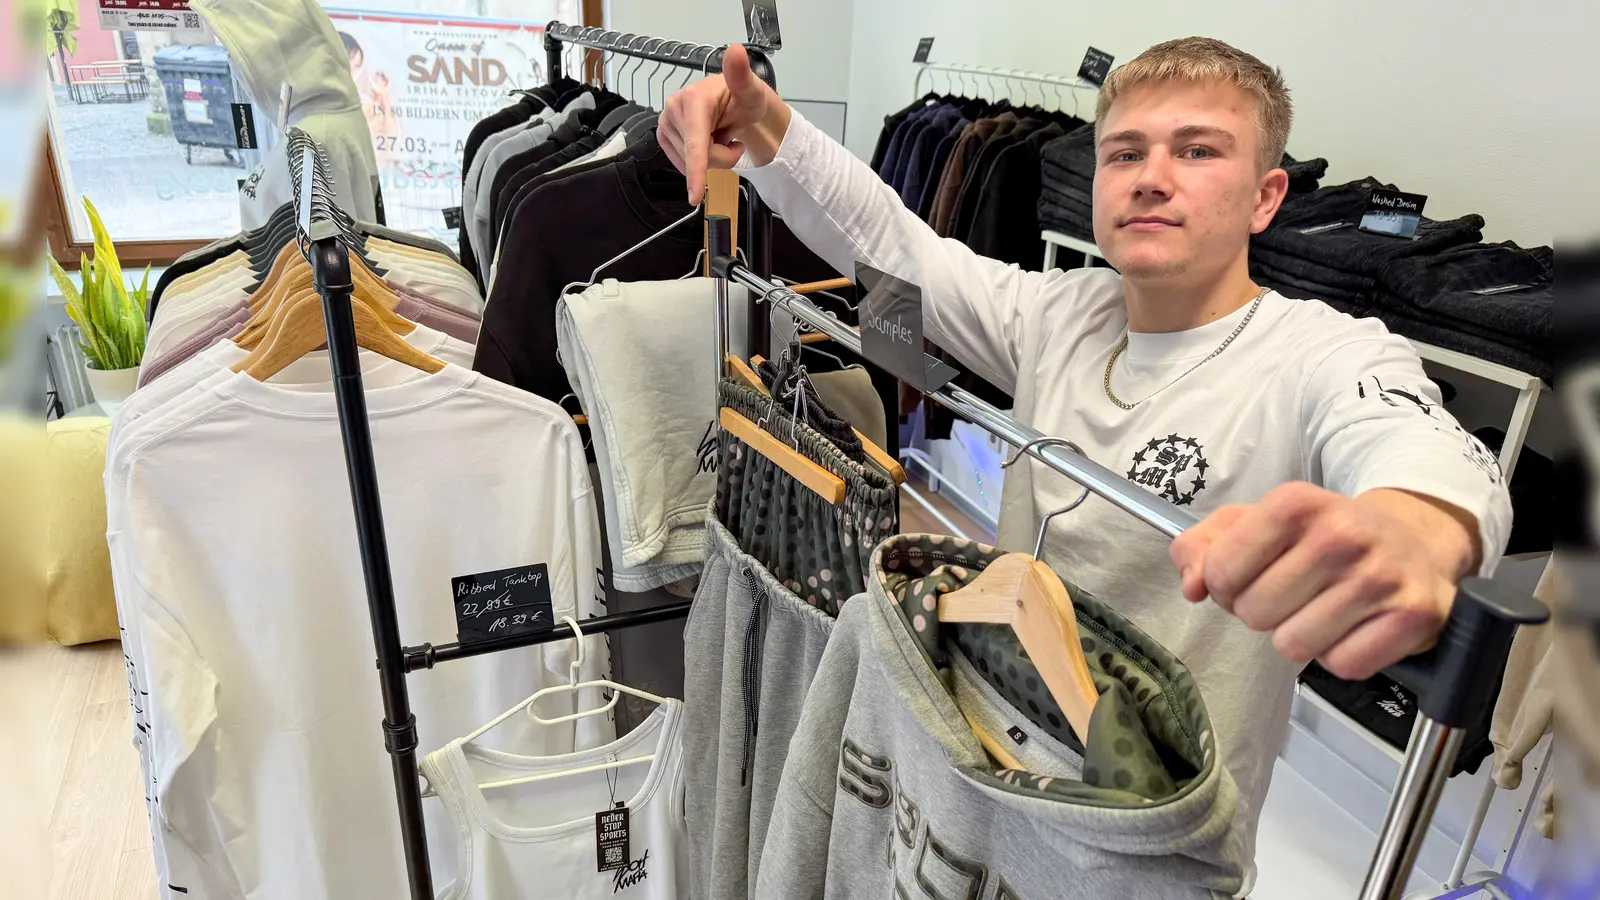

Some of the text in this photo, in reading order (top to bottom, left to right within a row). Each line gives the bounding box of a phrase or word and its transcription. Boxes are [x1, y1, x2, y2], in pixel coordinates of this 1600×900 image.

[471, 41, 485, 56] of
[407, 54, 507, 86] SAND
[407, 85, 449, 95] IRINA
[406, 106, 460, 121] BILDERN
[376, 134, 432, 155] 27.03.
[1372, 194, 1396, 207] Washed
[868, 301, 913, 345] Samples
[457, 580, 497, 597] Ribbed
[604, 822, 622, 832] STOP
[600, 829, 627, 841] SPORTS
